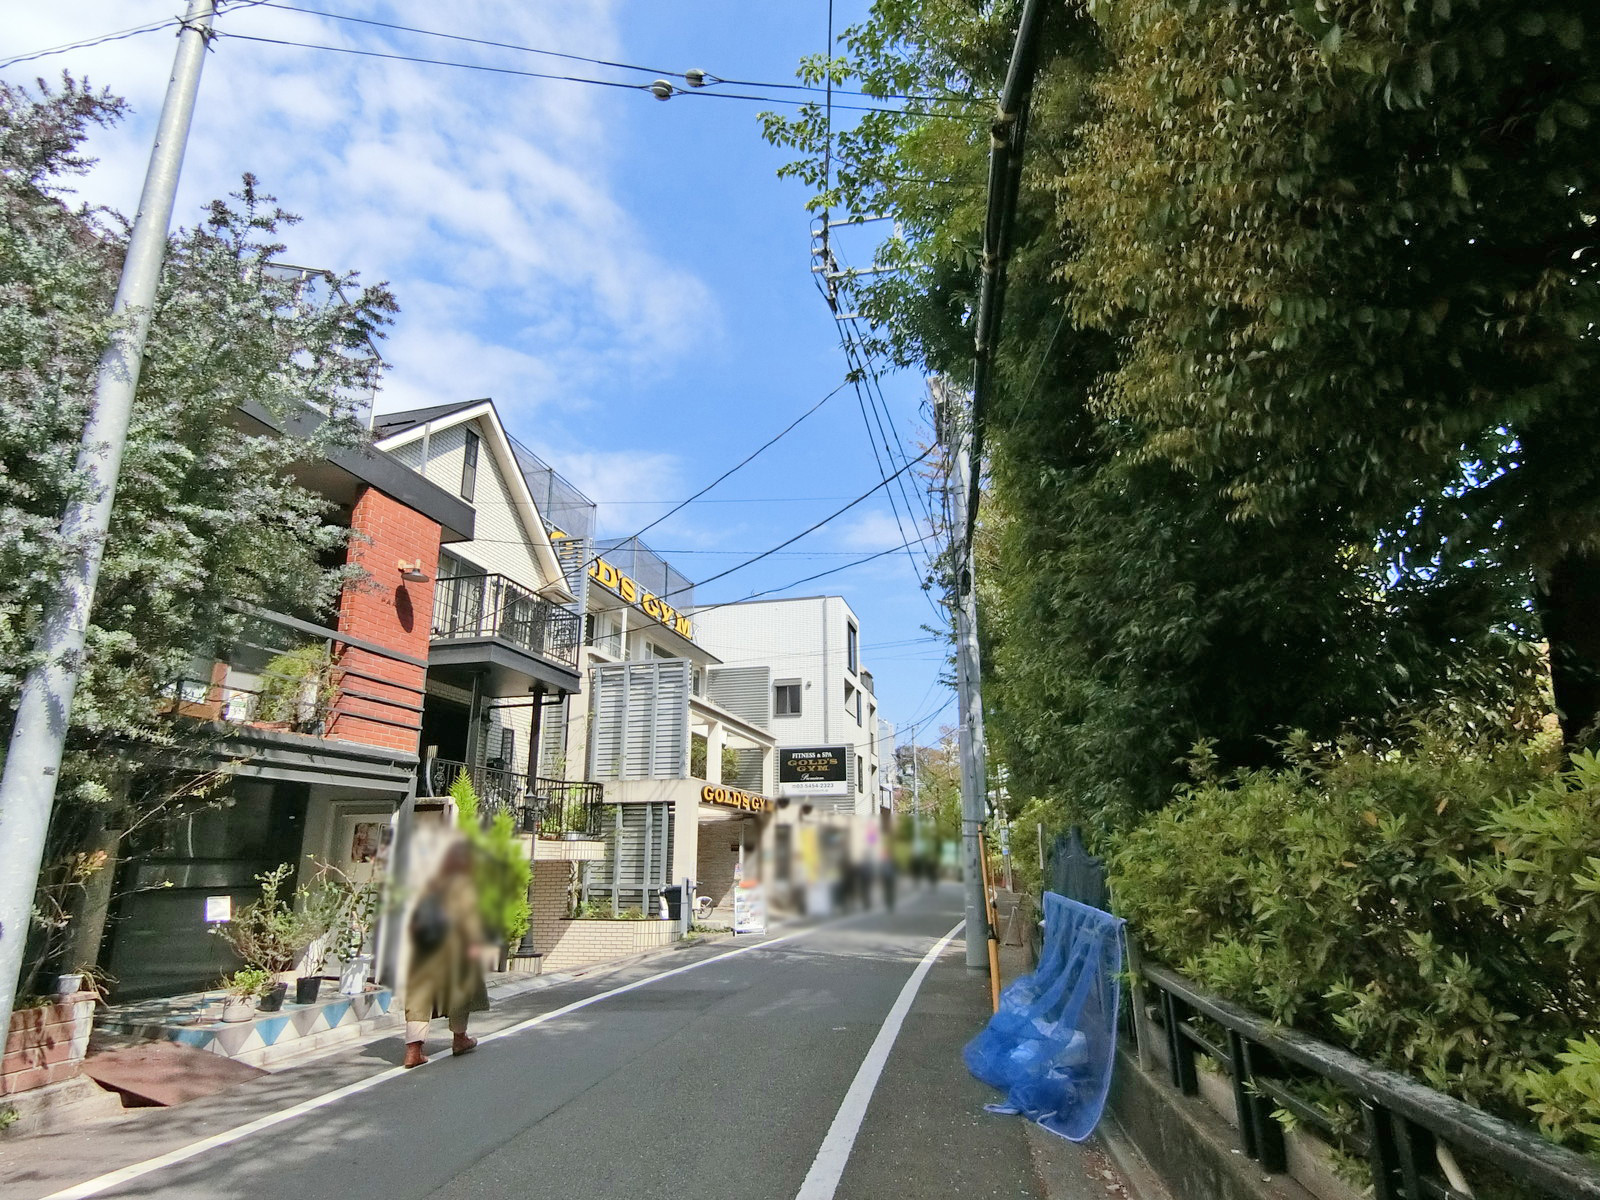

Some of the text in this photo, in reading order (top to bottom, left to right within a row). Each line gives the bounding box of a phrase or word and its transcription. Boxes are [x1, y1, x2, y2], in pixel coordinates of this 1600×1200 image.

[641, 593, 693, 640] GYM
[787, 758, 838, 766] GOLD'S
[703, 785, 750, 809] GOLD'S
